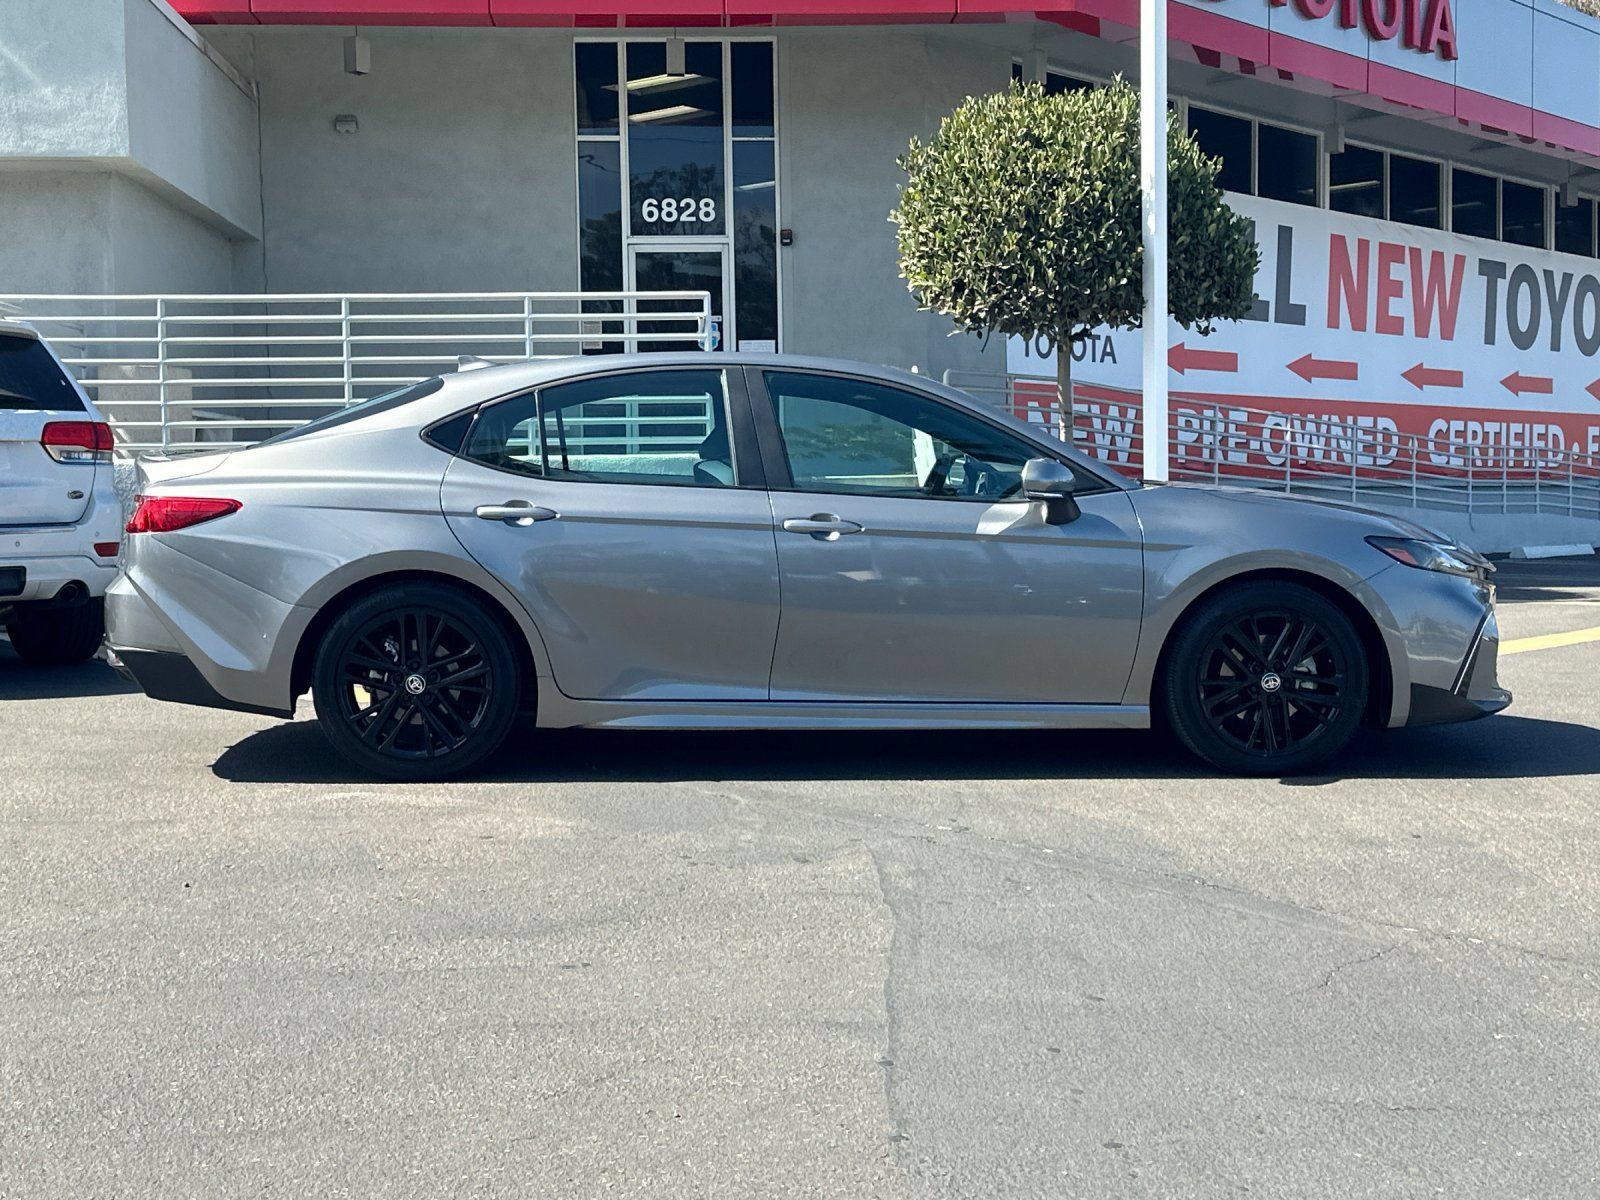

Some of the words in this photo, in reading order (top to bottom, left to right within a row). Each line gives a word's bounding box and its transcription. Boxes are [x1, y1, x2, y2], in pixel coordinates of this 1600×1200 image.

[1269, 0, 1458, 60] OTA
[642, 198, 716, 223] 6828
[1327, 233, 1466, 341] NEW
[1022, 333, 1117, 364] OOTA
[1177, 408, 1399, 466] PRE-OWNED
[1428, 418, 1565, 468] CERTIFIED
